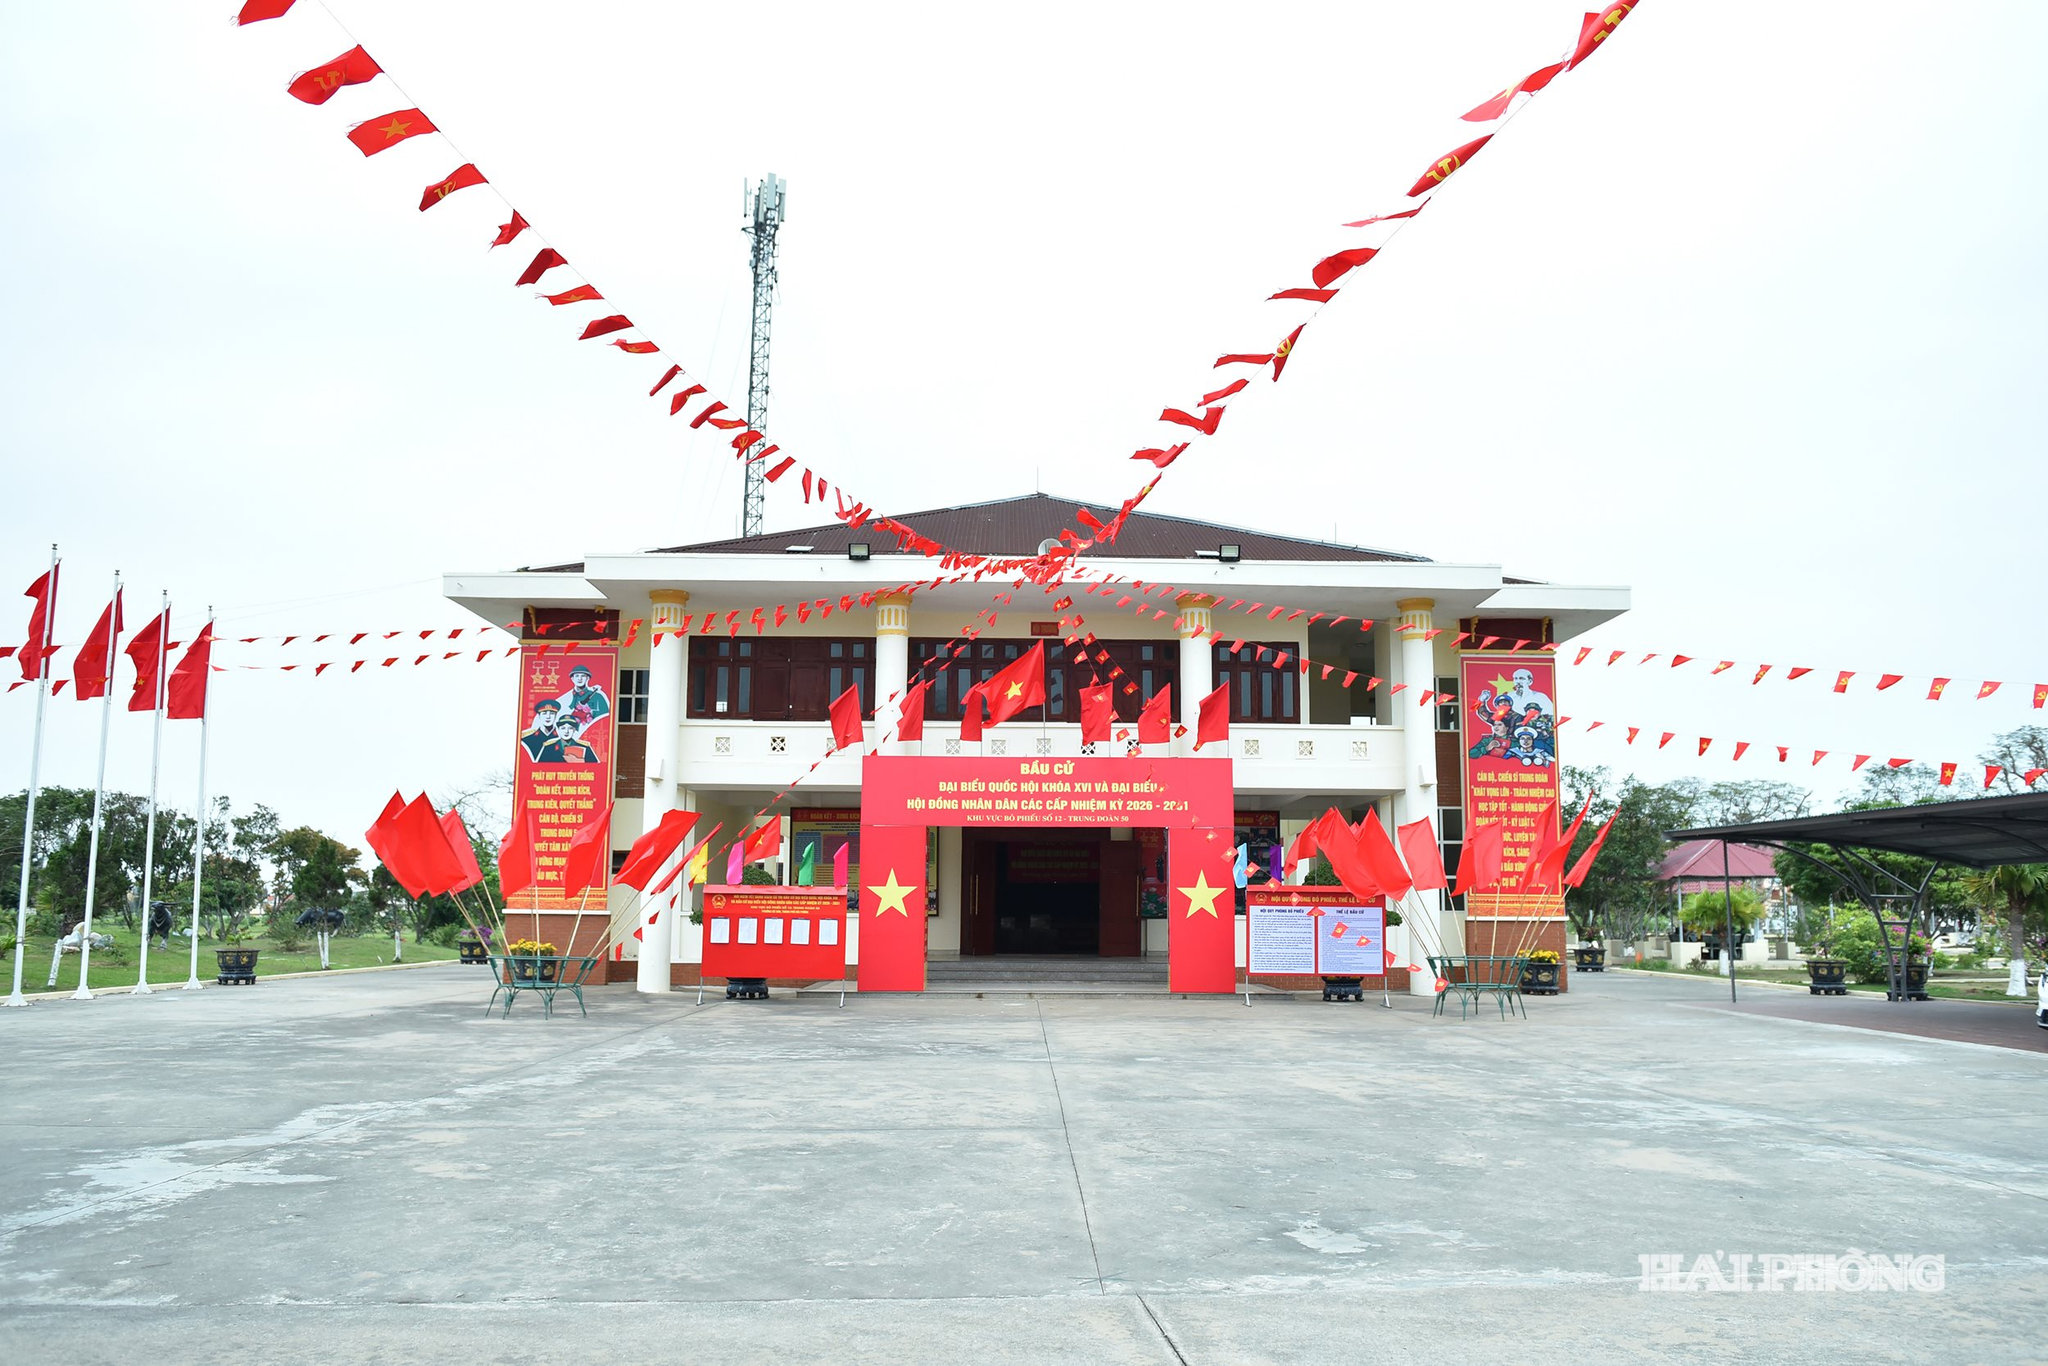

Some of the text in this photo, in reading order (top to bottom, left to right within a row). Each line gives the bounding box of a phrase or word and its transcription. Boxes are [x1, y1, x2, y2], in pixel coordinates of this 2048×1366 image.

[1020, 760, 1075, 775] BẦU CỬ
[939, 778, 1158, 795] ĐẠI BIỂU QUỐC HỘI KHÓA XVI VÀ ĐẠI BIỂU
[907, 797, 925, 811] HỘI
[928, 796, 959, 810] ĐỒNG
[961, 797, 992, 810] NHÂN
[995, 797, 1018, 810] DÂN
[1021, 798, 1042, 810] CÁC
[1046, 796, 1068, 810] CẤP
[1071, 798, 1106, 812] NHIỆM
[1110, 798, 1124, 811] KỲ
[1126, 800, 1152, 811] 2026
[986, 815, 1003, 823] VỰC
[1004, 814, 1015, 822] BỎ
[1017, 813, 1040, 822] PHIẾU
[1042, 813, 1053, 822] SỐ
[1097, 814, 1119, 822] ĐOÀN
